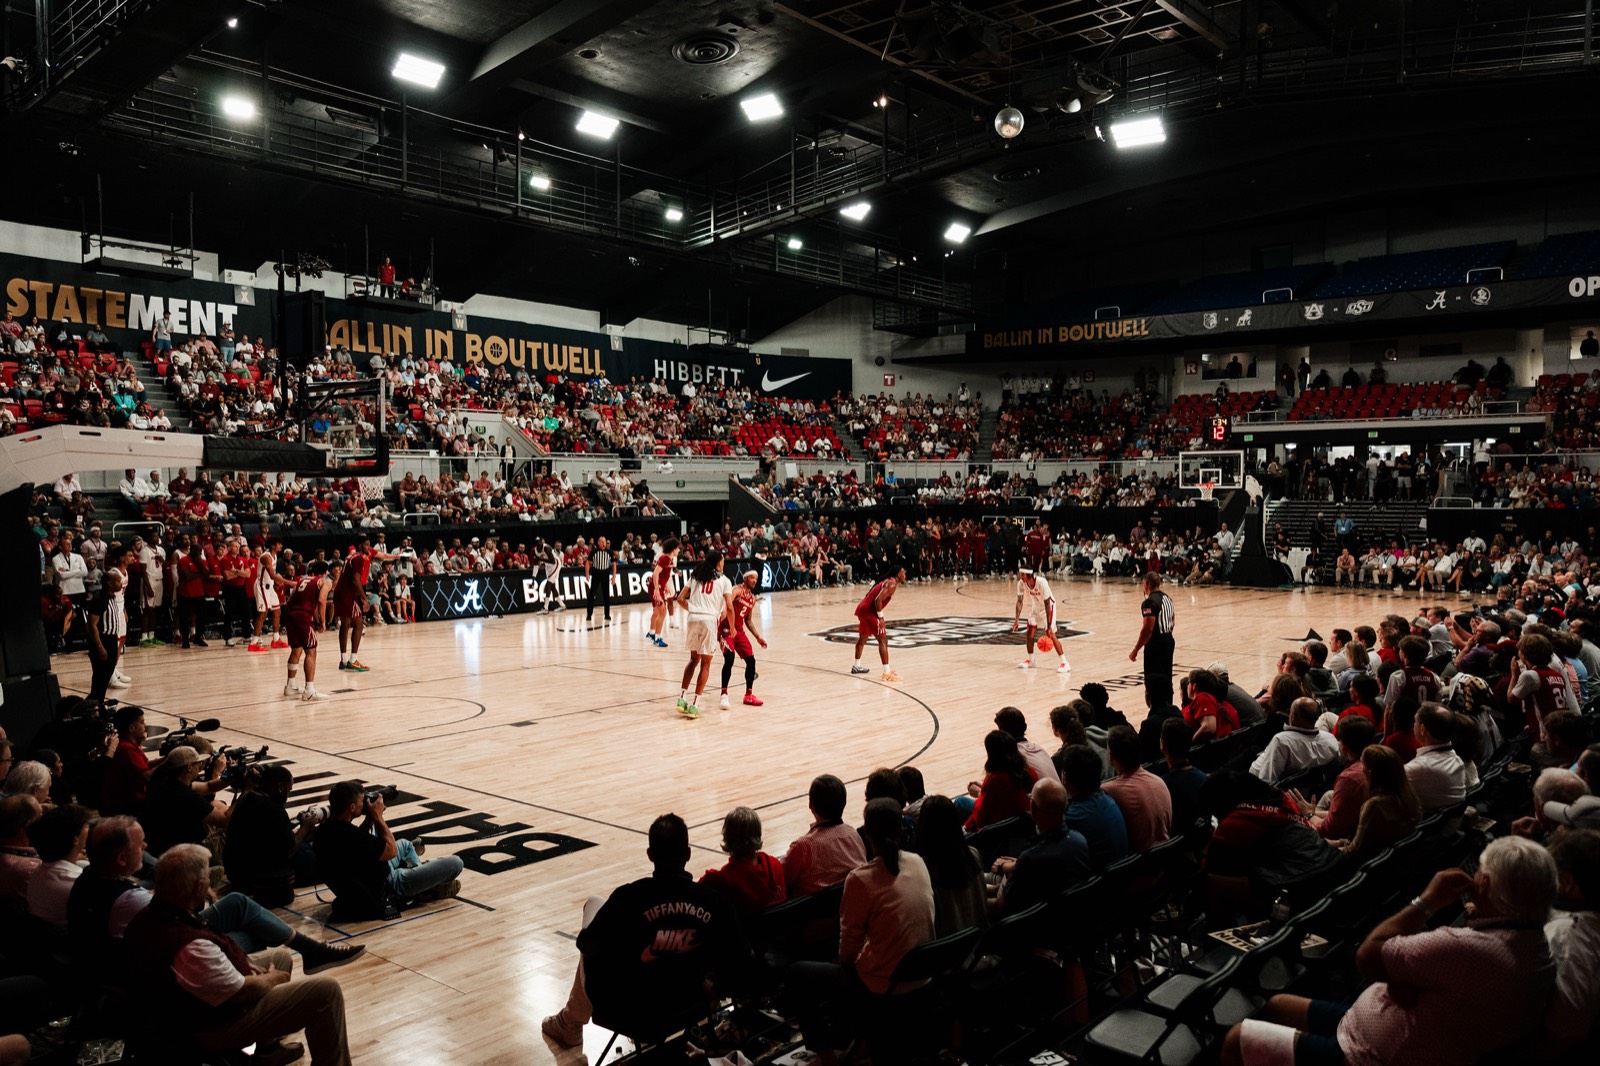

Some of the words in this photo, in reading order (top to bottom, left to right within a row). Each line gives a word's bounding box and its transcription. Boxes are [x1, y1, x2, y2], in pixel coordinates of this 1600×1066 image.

[241, 291, 249, 304] X
[6, 277, 239, 337] STATEMENT
[455, 318, 464, 329] W
[983, 329, 1033, 349] BALLIN
[1037, 327, 1053, 345] IN
[1058, 319, 1149, 343] BOUTWELL
[325, 319, 413, 356] ALLIN
[424, 328, 454, 361] IN
[465, 333, 606, 376] BOUTWELL
[654, 359, 743, 384] HIBBETT
[1186, 362, 1197, 374] R
[884, 375, 894, 386] T
[1084, 370, 1094, 382] S
[1213, 426, 1225, 440] 12
[541, 465, 548, 476] B
[701, 580, 714, 594] 10
[740, 606, 747, 617] 2
[643, 901, 712, 923] TIFFANY&CO
[651, 928, 697, 952] NIKE
